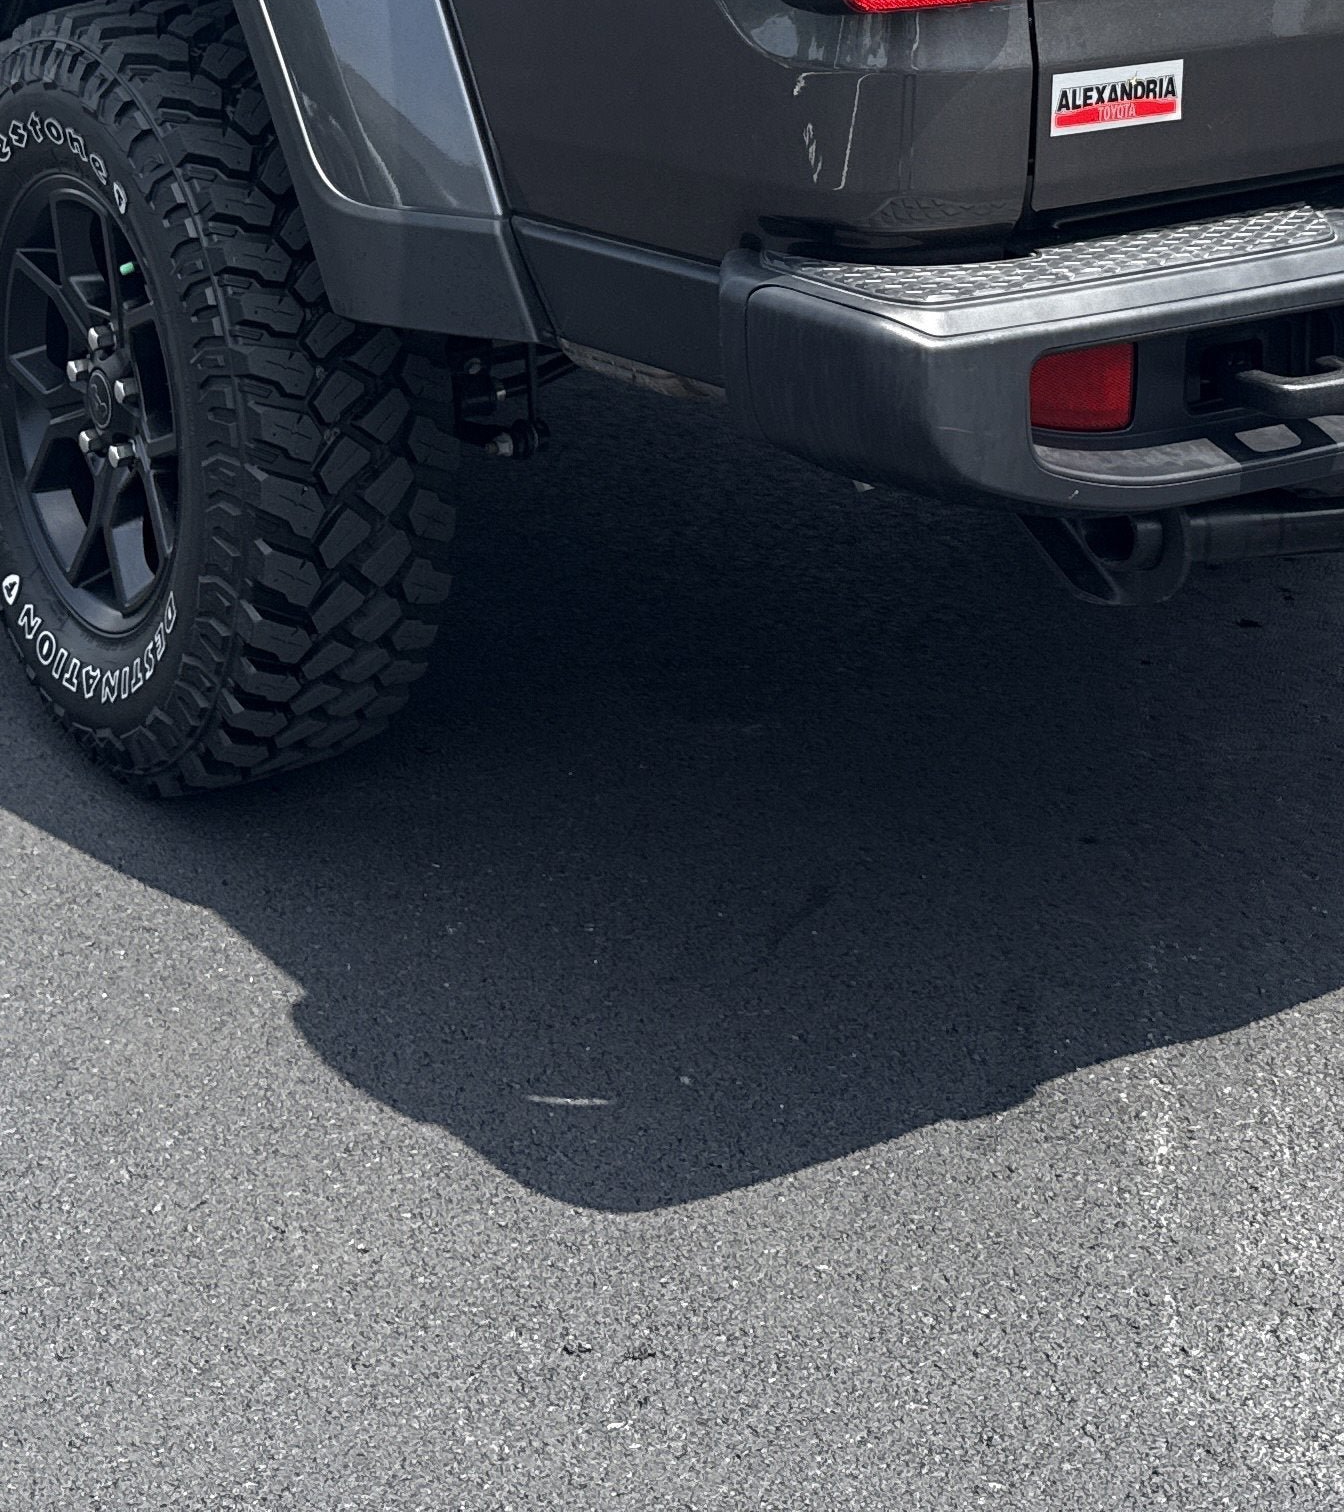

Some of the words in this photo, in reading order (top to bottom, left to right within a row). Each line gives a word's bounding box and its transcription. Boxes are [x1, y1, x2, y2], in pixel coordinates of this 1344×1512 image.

[1057, 76, 1176, 111] ALEXANDRIA
[1097, 103, 1136, 122] TOYOTA
[17, 590, 178, 704] DESTINATION
